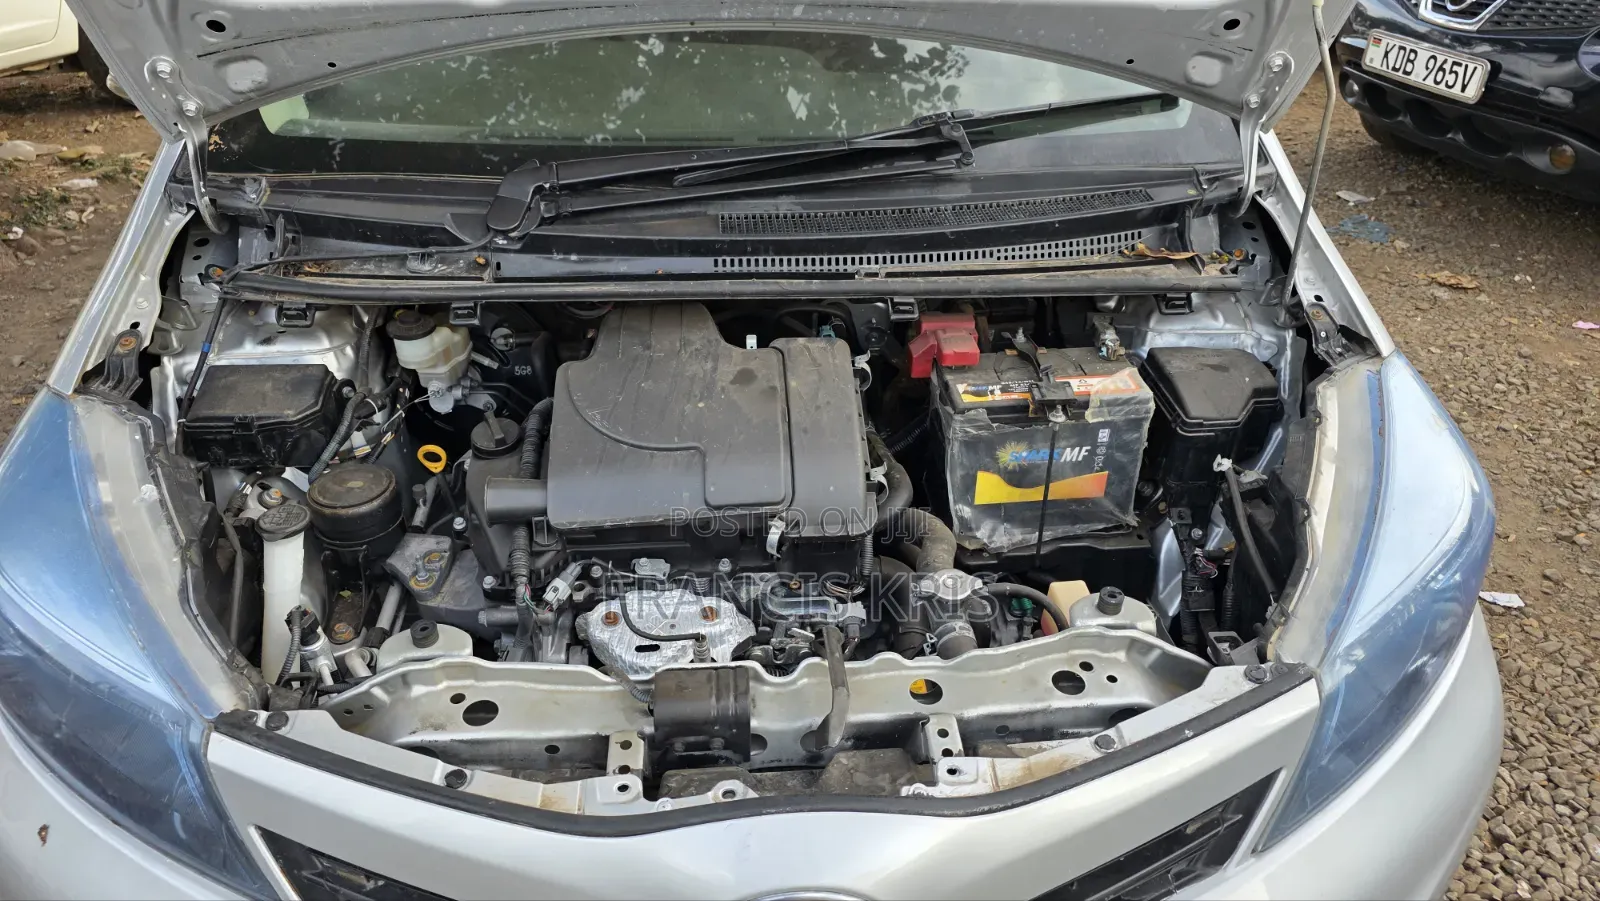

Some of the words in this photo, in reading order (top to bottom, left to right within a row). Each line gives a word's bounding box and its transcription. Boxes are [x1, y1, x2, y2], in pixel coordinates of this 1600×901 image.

[1380, 41, 1419, 76] KDB
[1422, 54, 1478, 94] 965V
[514, 365, 533, 376] 5G8
[1060, 446, 1091, 463] MF
